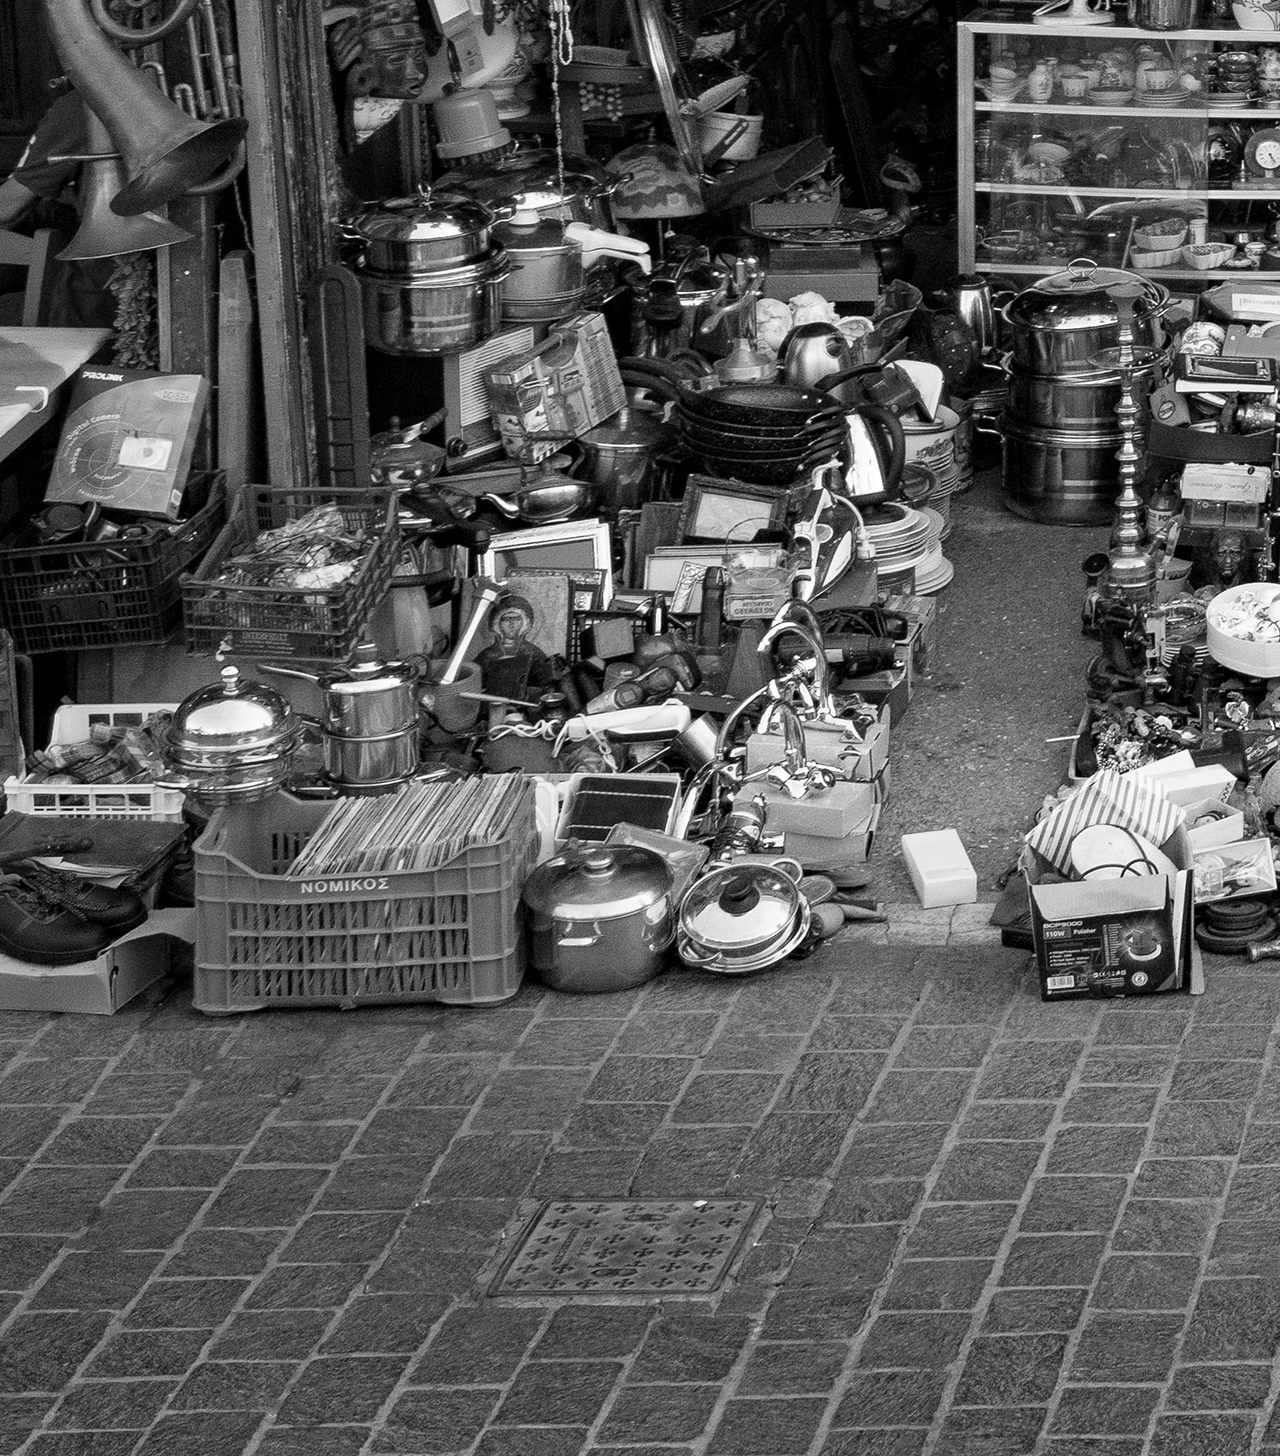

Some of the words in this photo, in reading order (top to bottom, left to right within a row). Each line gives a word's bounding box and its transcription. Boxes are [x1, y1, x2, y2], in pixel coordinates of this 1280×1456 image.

[66, 419, 91, 441] Digital
[734, 607, 763, 615] EDWARD
[301, 877, 390, 895] ΝΟΜΙΚΟΣ
[1045, 930, 1066, 939] 110W
[1072, 927, 1098, 936] Polisher
